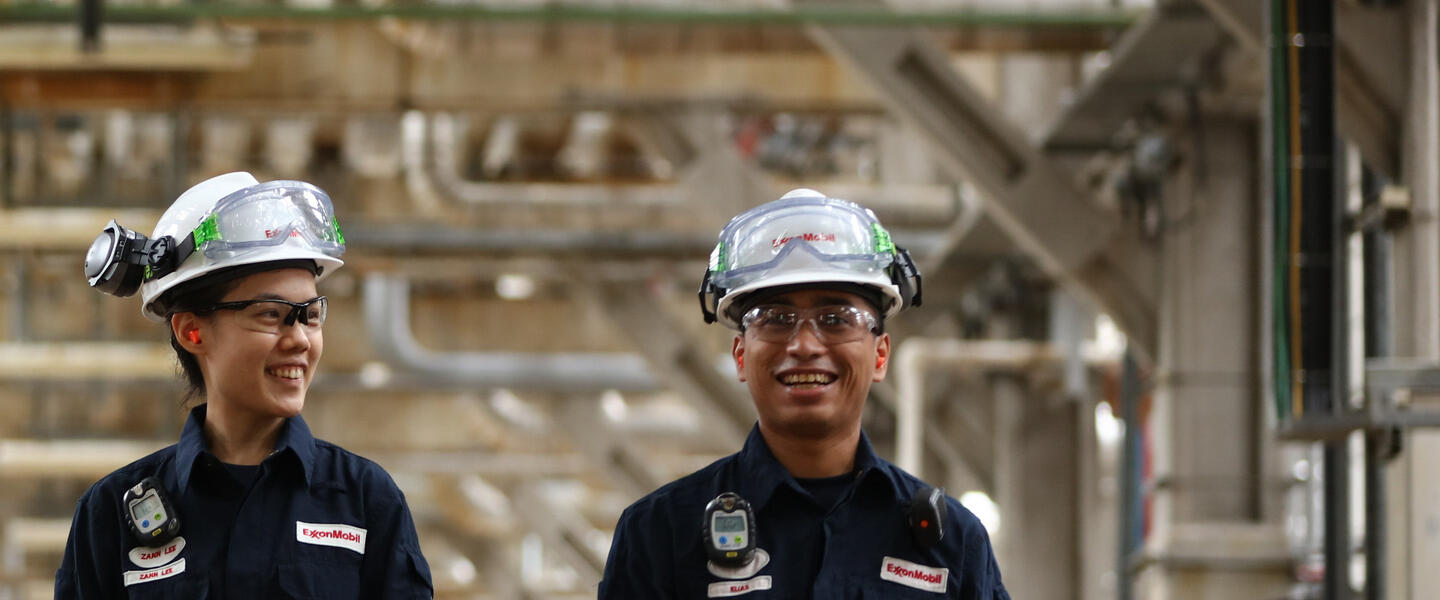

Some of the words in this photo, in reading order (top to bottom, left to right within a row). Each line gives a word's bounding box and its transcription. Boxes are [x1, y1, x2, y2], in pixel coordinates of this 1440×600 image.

[302, 528, 361, 543] ExxonMobil
[164, 544, 177, 555] LEE
[161, 567, 173, 576] LEE
[886, 563, 943, 584] ExxonMobil
